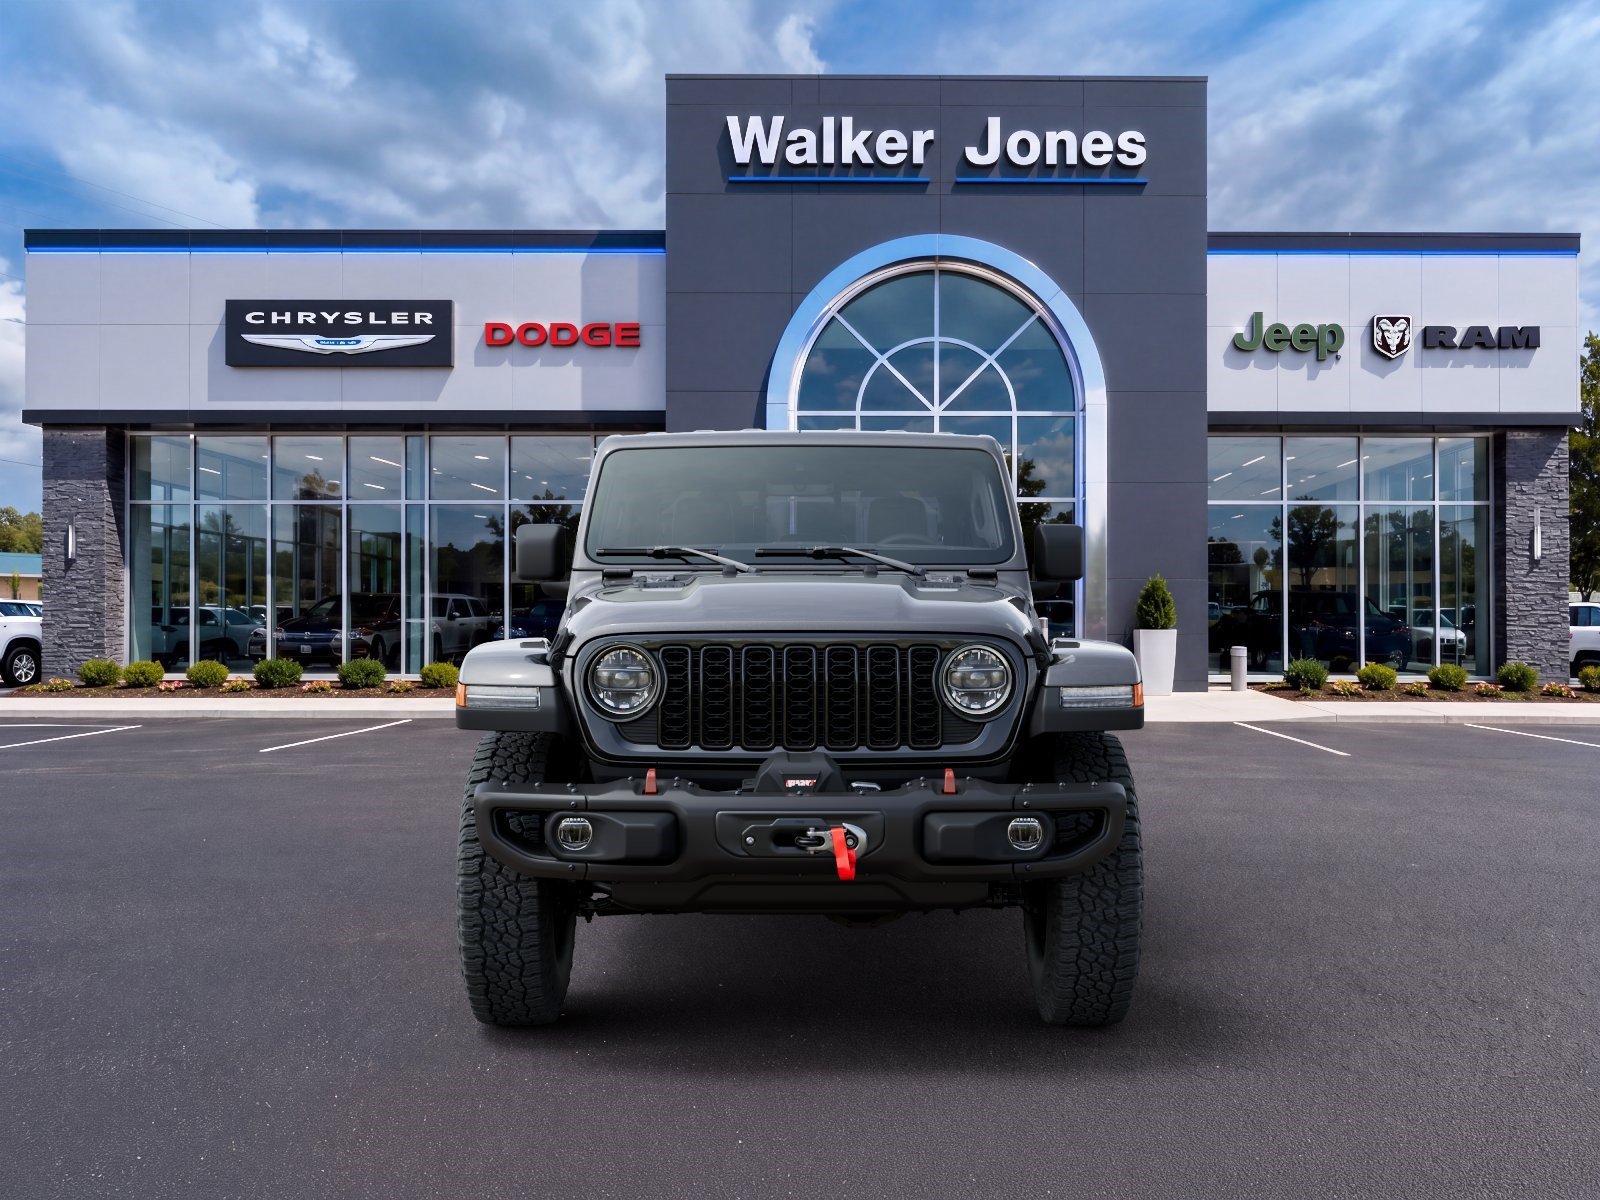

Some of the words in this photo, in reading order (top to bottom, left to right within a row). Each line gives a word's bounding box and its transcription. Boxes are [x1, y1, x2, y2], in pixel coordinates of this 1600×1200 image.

[726, 115, 934, 165] Walker
[964, 116, 1147, 166] Jones
[245, 311, 433, 324] CHRYSLER
[485, 322, 640, 346] DODGE
[1233, 311, 1345, 361] Jeep
[1423, 325, 1541, 348] RAM
